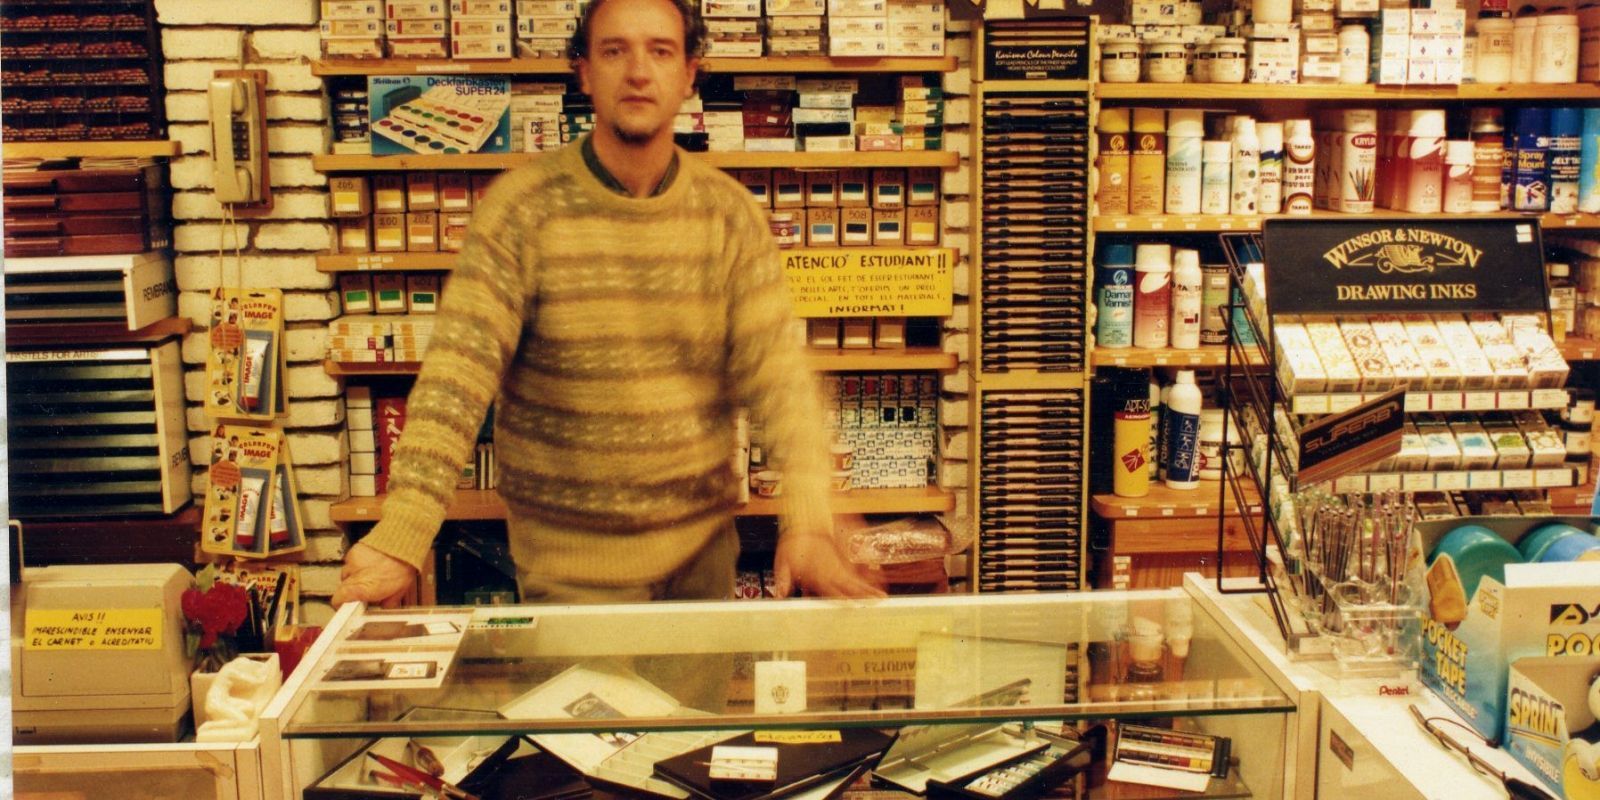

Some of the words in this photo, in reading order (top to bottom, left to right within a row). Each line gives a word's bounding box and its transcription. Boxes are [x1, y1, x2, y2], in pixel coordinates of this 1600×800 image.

[426, 77, 506, 87] Deckfarbkasten
[455, 87, 493, 96] SUPER
[494, 87, 506, 96] 24
[1323, 229, 1394, 270] WINSOR
[1394, 228, 1407, 242] &
[1408, 228, 1483, 268] NEWTON
[1336, 284, 1427, 300] DRAWING
[1429, 283, 1478, 299] INKS
[244, 310, 274, 320] IMAGE
[51, 351, 71, 360] FOR
[1304, 401, 1398, 454] SUPERB
[243, 449, 272, 458] IMAGE
[71, 613, 94, 621] AVIS
[31, 637, 42, 647] EL
[46, 637, 84, 647] CARNET
[1421, 611, 1468, 671] POCKET
[1435, 650, 1466, 698] TAPE
[1379, 685, 1409, 696] Pentel
[1511, 687, 1563, 738] SPRINT
